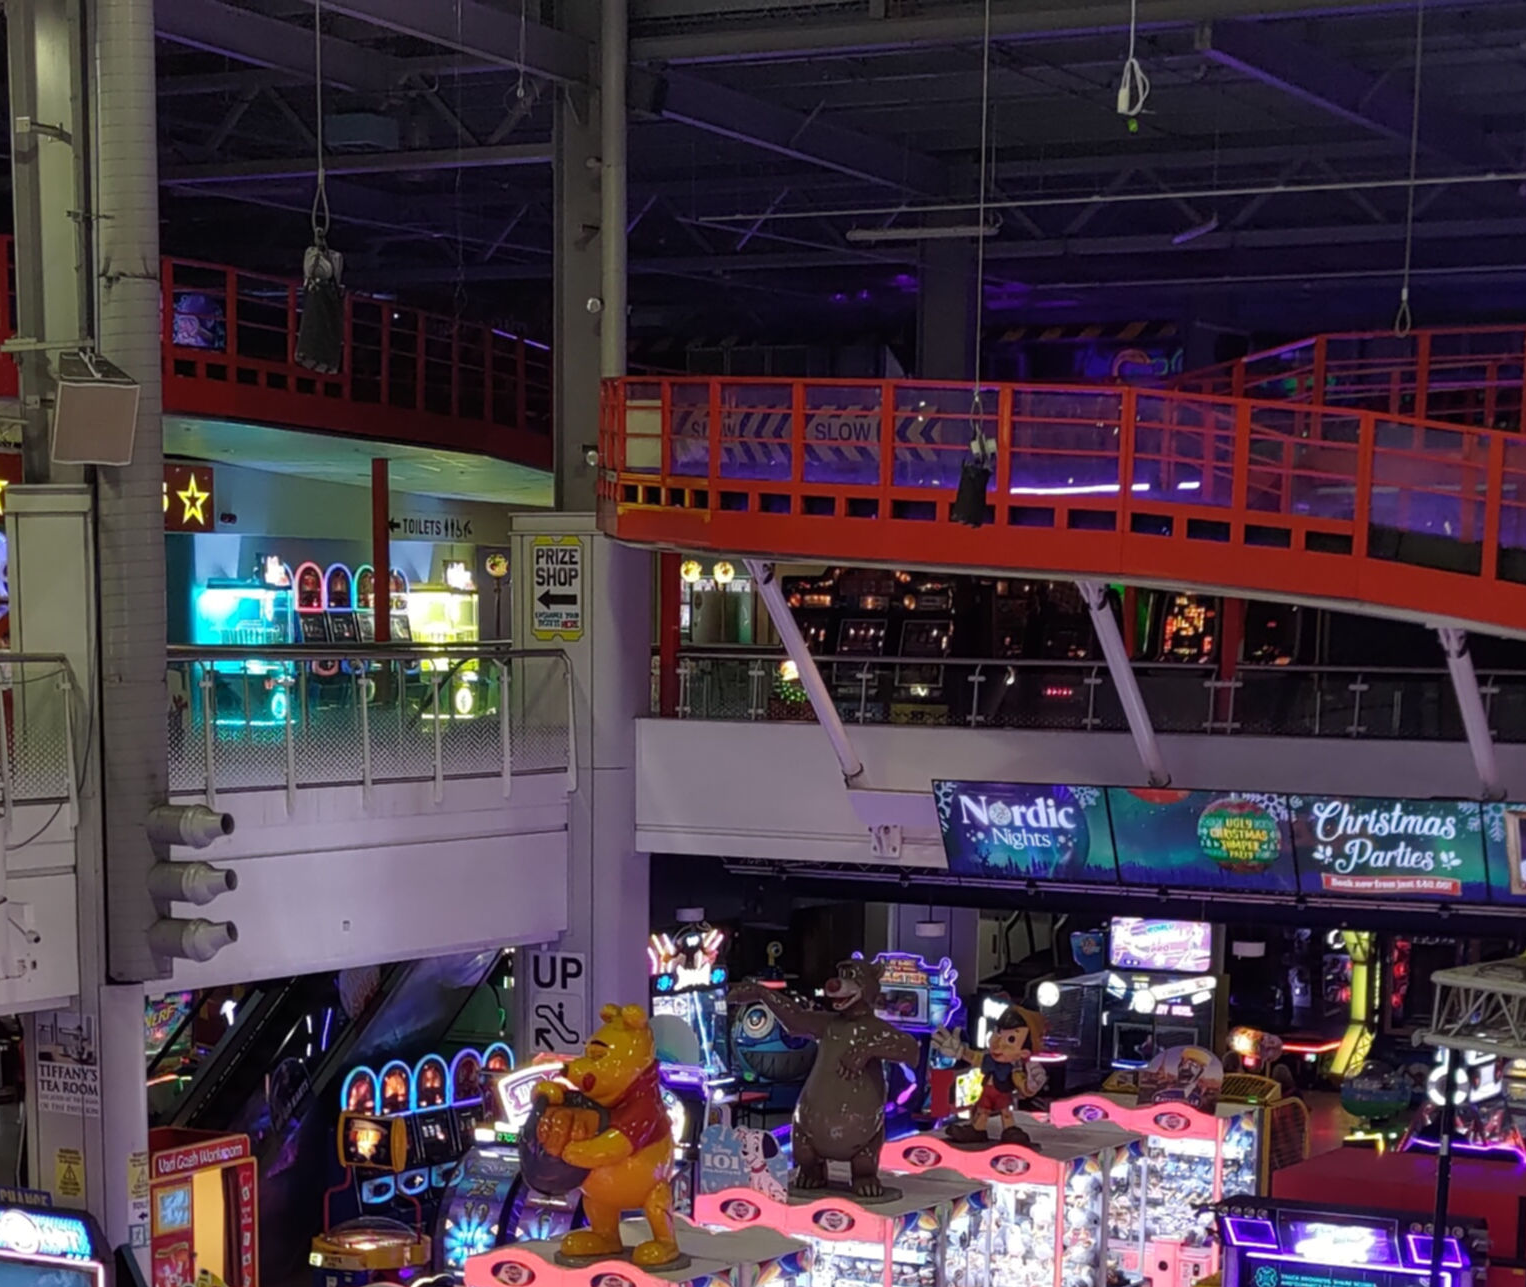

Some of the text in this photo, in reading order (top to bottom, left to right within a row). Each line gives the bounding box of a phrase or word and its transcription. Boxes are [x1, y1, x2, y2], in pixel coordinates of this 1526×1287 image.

[815, 422, 871, 442] SLOW
[402, 517, 441, 536] TOILETS
[535, 548, 579, 567] PRIZE
[535, 567, 579, 588] SHOP
[960, 795, 1075, 831] Nordic
[1313, 800, 1457, 842] Christmas
[993, 827, 1052, 849] Nights
[1335, 838, 1435, 874] Parties
[532, 955, 583, 989] UP
[38, 1063, 98, 1083] TIFFANY'S
[39, 1079, 99, 1096] TEA ROOM
[704, 1154, 740, 1169] 101
